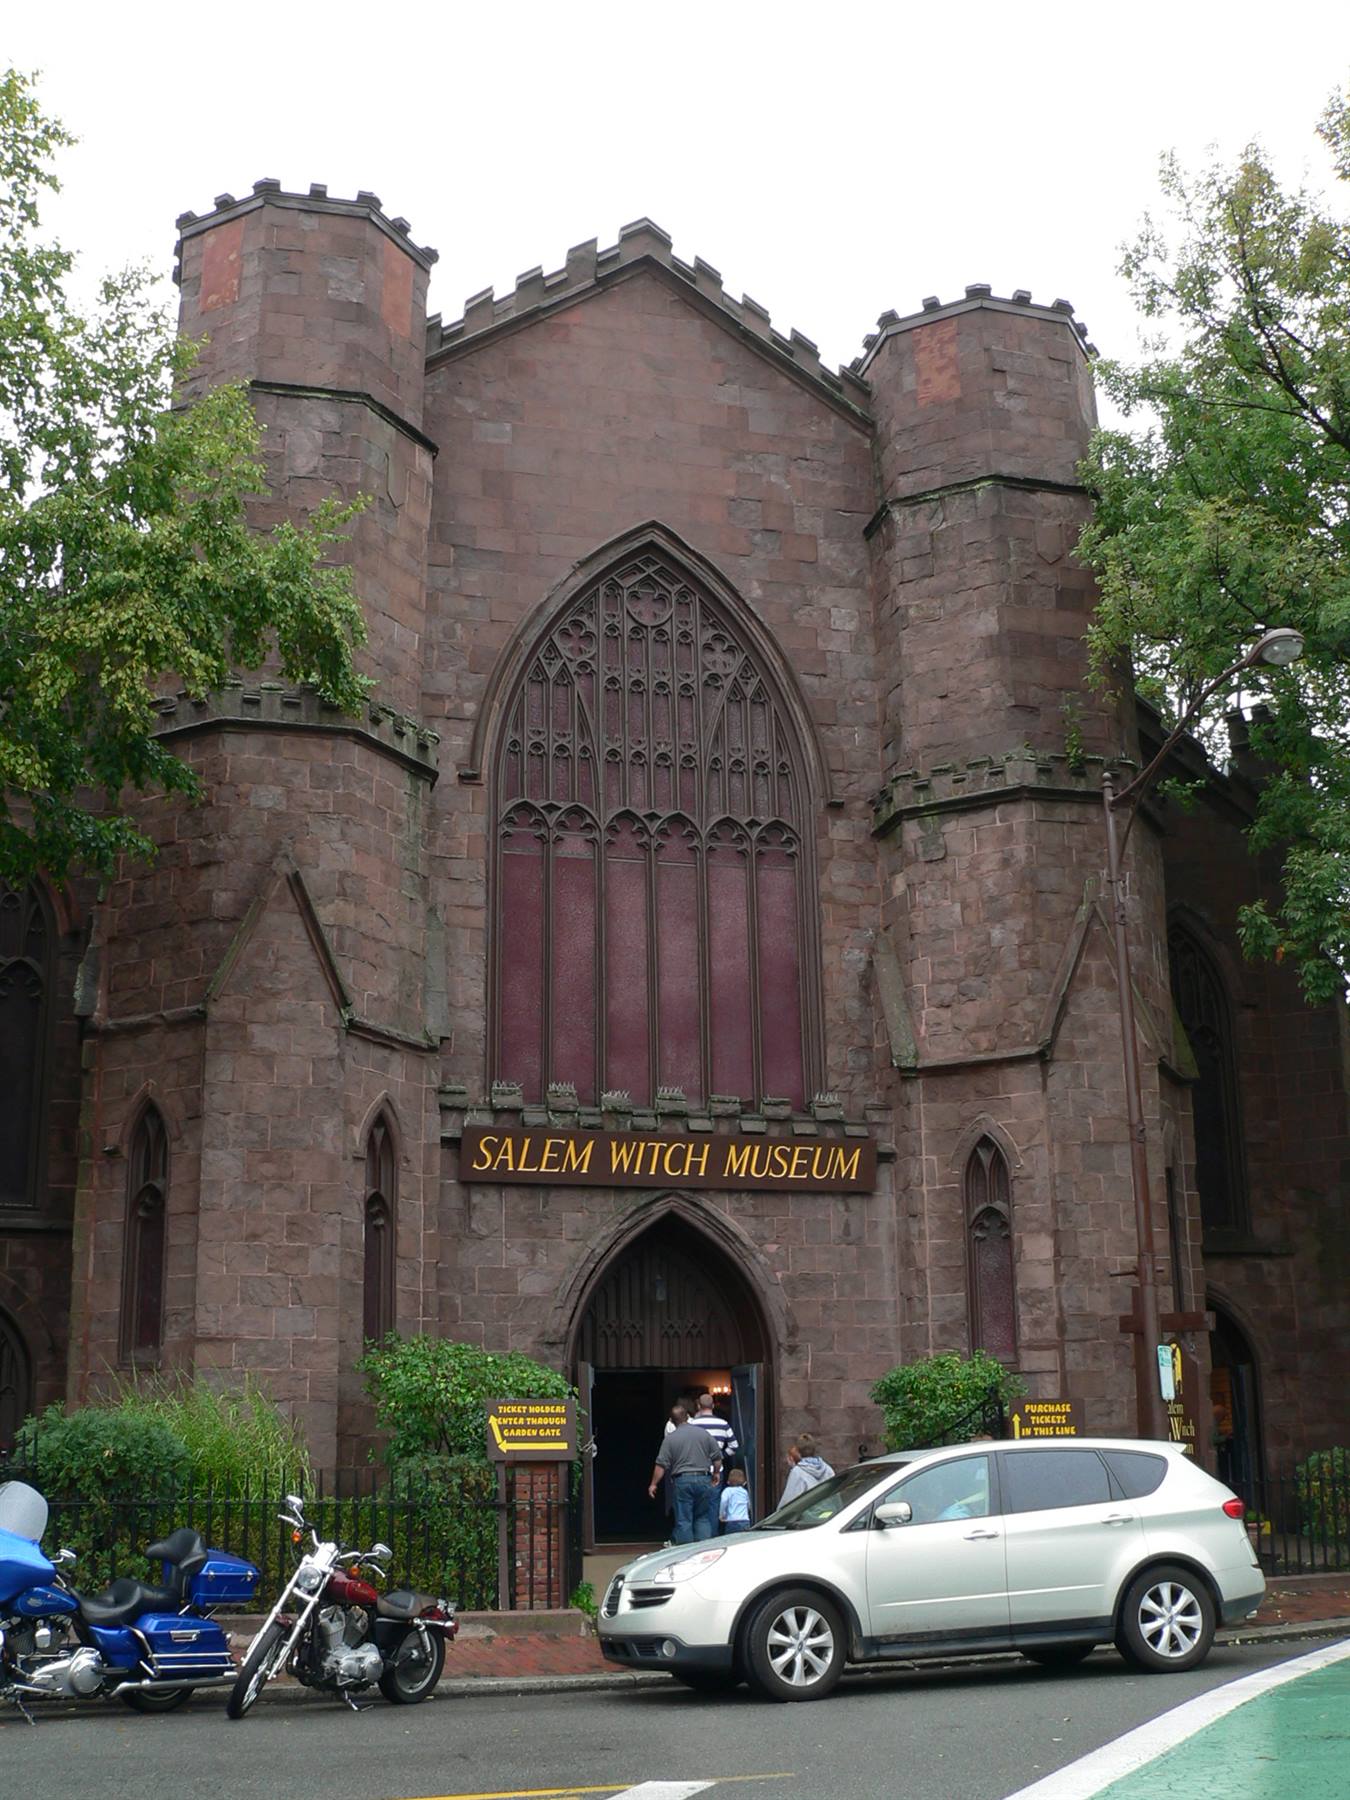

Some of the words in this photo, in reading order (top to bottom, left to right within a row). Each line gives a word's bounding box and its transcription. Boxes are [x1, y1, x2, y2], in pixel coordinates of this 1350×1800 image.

[472, 1135, 595, 1174] SALEM
[610, 1140, 711, 1177] WITCH
[723, 1144, 862, 1180] MUSEUM
[498, 1405, 527, 1414] TICKET
[529, 1405, 566, 1414] HOLDERS
[1025, 1403, 1072, 1414] PURCHASE
[498, 1417, 525, 1425] ENTER
[526, 1417, 567, 1426] THROUGH
[1030, 1415, 1067, 1425] TICKETS
[503, 1428, 537, 1437] GARDEN
[539, 1428, 561, 1437] GATE
[1021, 1427, 1031, 1436] IN
[1033, 1427, 1054, 1436] THIS
[1055, 1426, 1076, 1435] LINE
